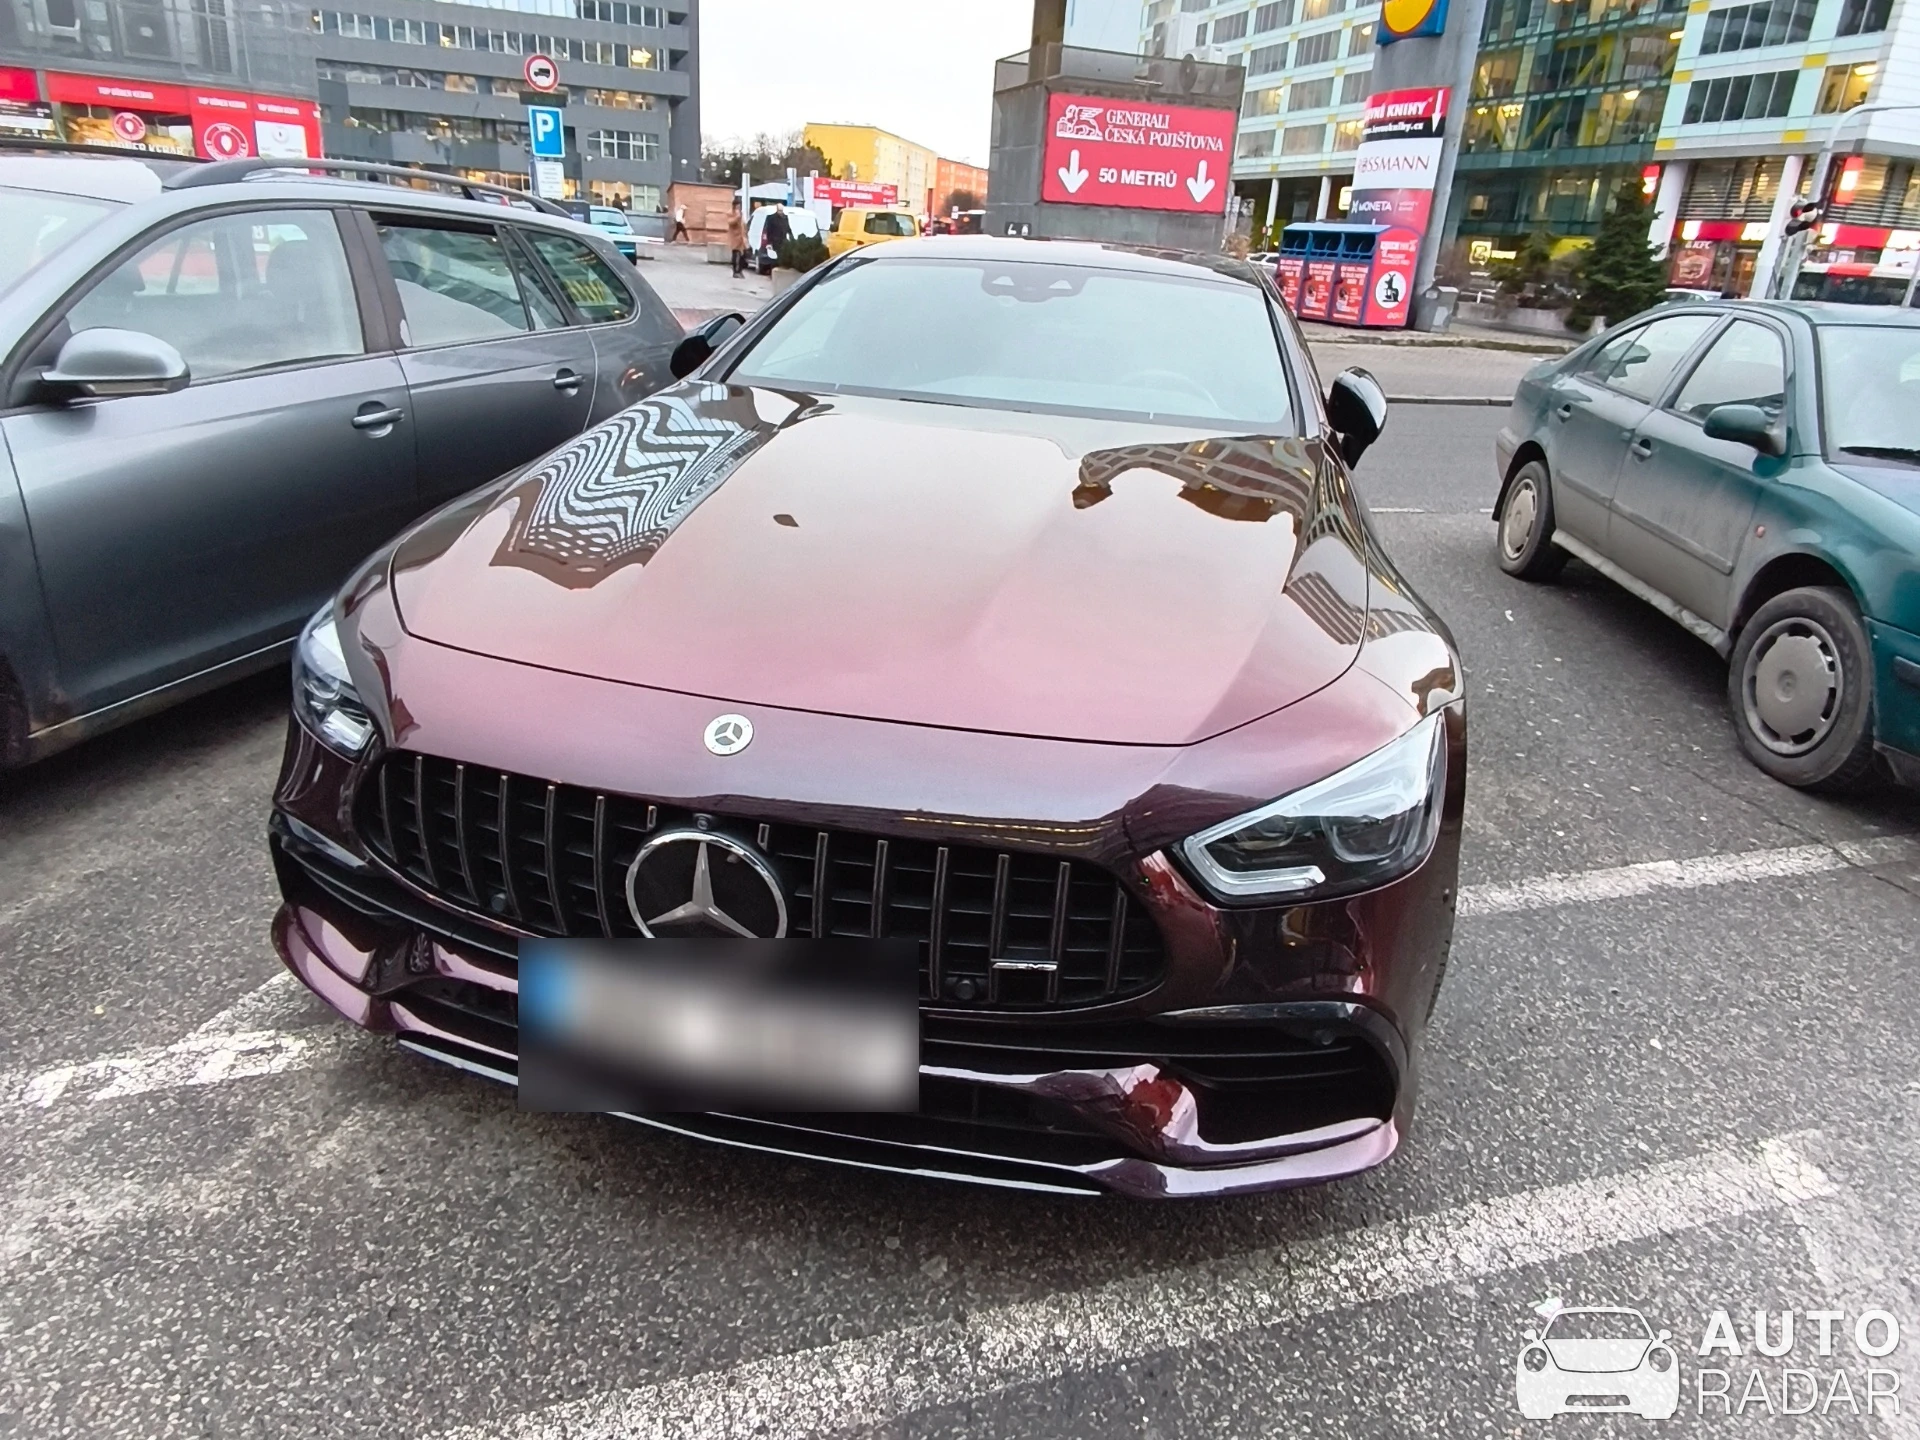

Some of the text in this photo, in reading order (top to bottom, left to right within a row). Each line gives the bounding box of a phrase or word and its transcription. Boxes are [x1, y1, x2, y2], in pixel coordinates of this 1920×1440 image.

[1106, 109, 1170, 129] GENERALI
[1386, 101, 1428, 118] KNIHY
[536, 112, 554, 142] P
[1104, 124, 1224, 152] ČESKÁ POJIŠŤOVNA
[1098, 168, 1178, 188] 50 METRŮ
[1358, 200, 1392, 212] MONETA
